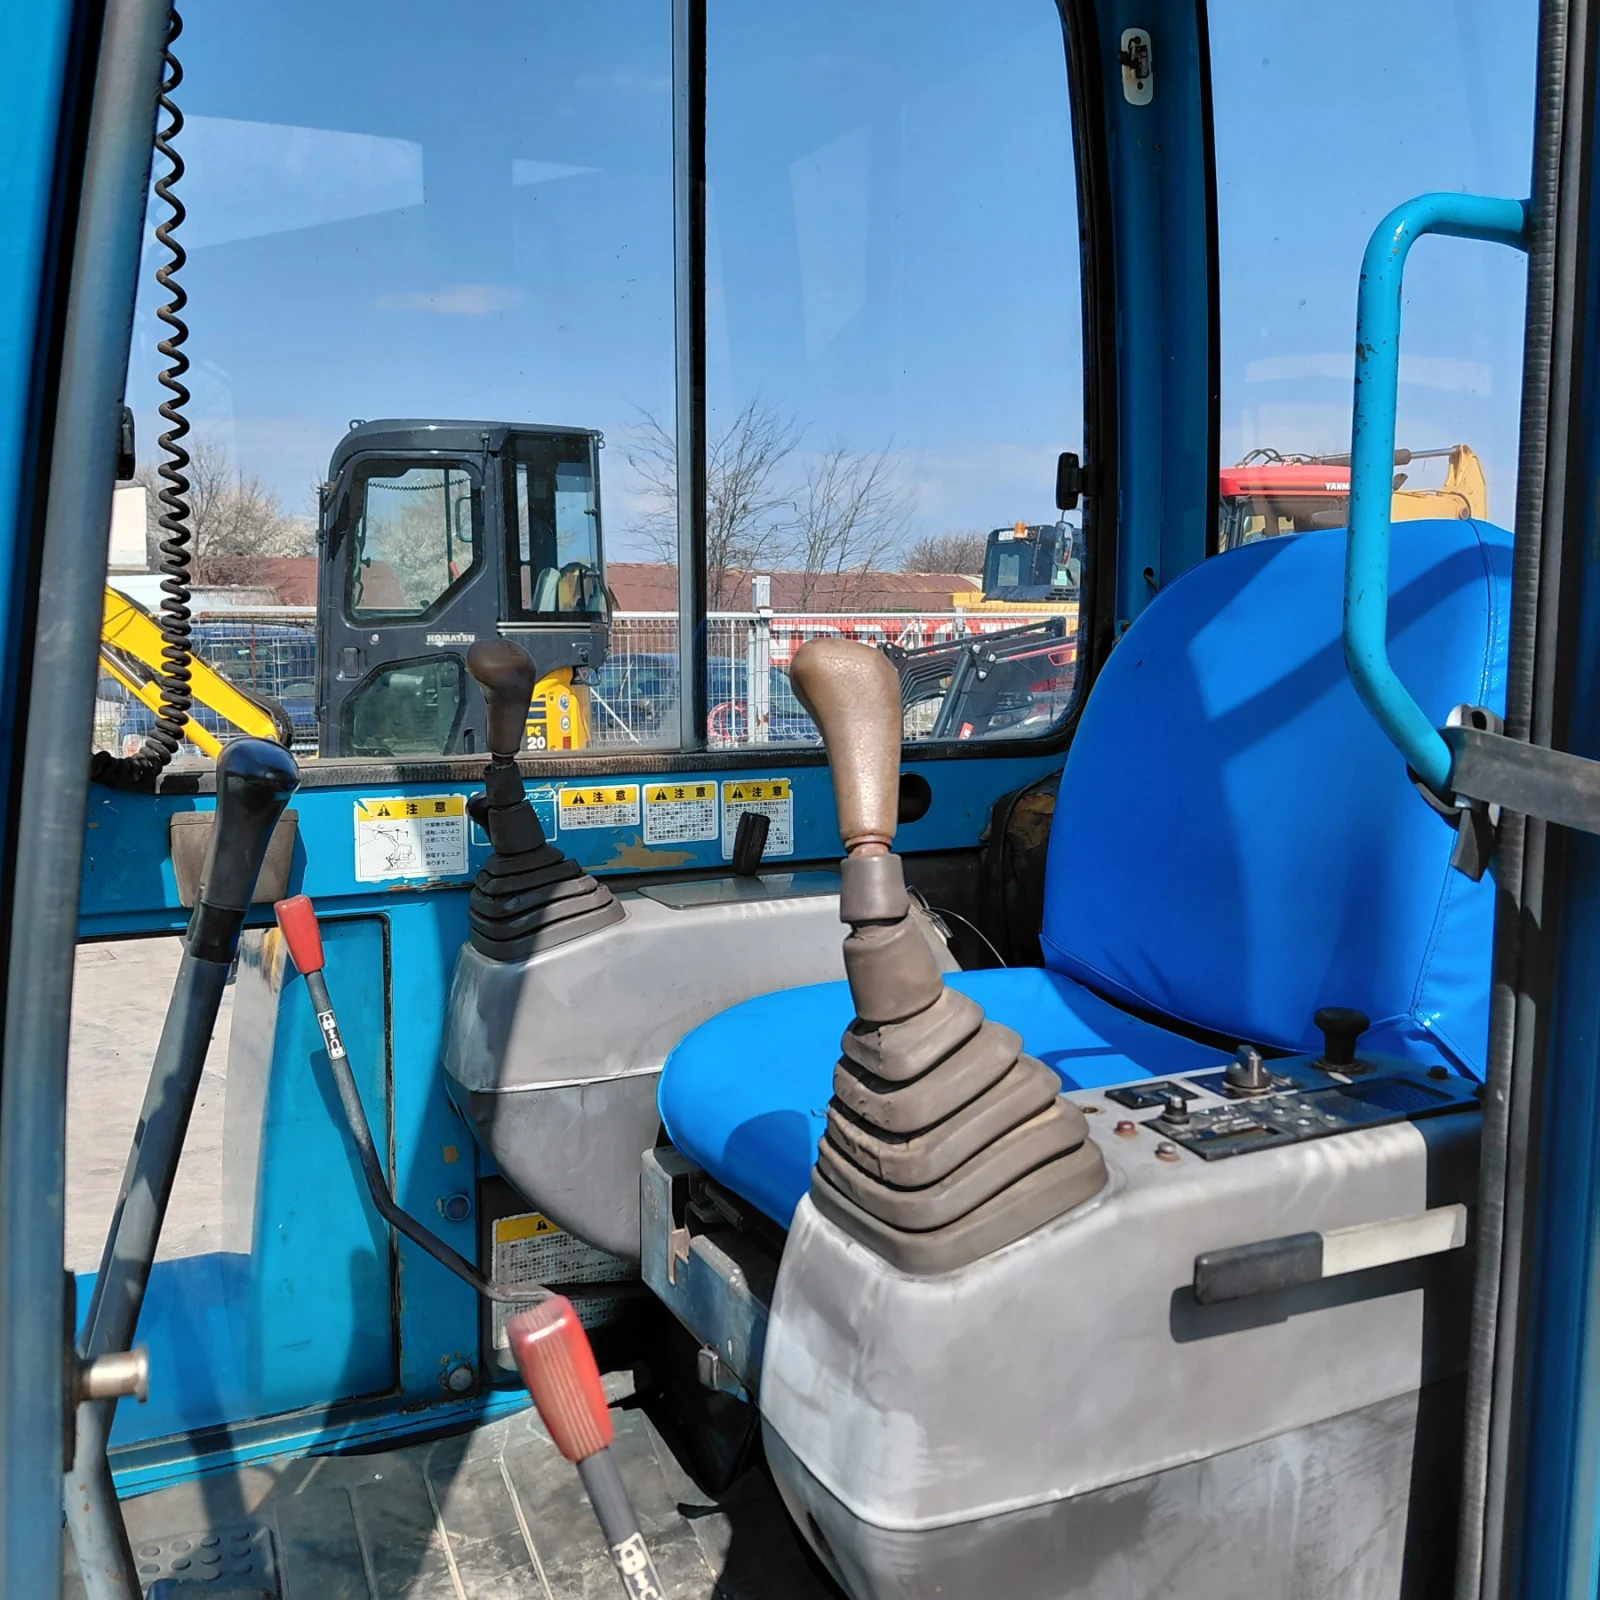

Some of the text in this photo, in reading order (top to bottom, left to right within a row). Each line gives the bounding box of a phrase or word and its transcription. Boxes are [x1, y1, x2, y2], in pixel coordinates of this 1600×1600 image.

[1325, 482, 1350, 490] YANM
[427, 634, 475, 642] KOMATSU
[526, 726, 541, 736] PC
[527, 737, 546, 749] 20
[593, 790, 626, 802] 注意
[406, 802, 446, 815] 注意
